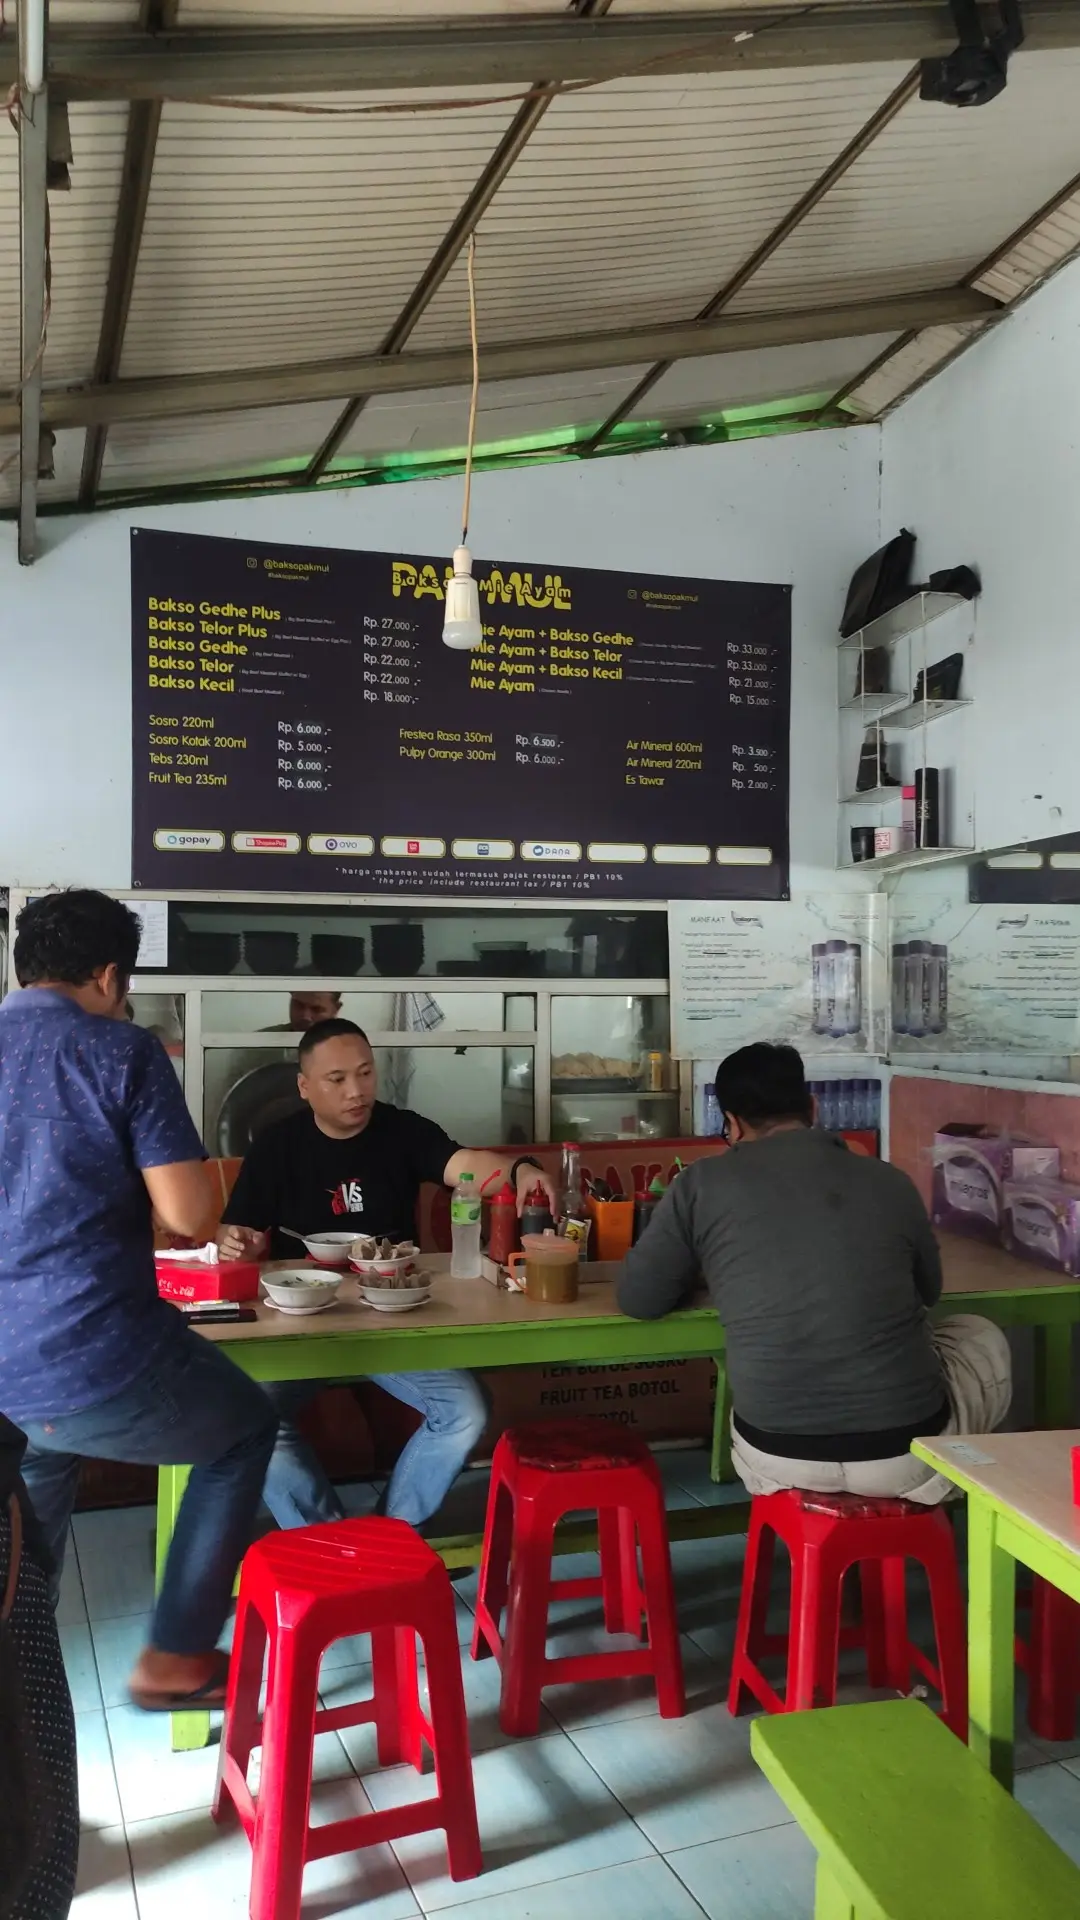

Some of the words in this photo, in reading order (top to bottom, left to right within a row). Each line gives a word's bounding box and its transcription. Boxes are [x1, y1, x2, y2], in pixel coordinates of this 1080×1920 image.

[263, 559, 329, 573] @baksopakmul
[521, 583, 571, 598] Ayam
[148, 597, 195, 614] Bakso
[199, 602, 248, 618] Gedhe
[252, 605, 281, 621] Plus
[148, 617, 195, 633] Bakso
[199, 620, 234, 636] Telor
[238, 623, 268, 638] Plus
[363, 616, 379, 629] Rp.
[363, 634, 379, 647] Rp.
[498, 624, 535, 641] Ayam
[538, 629, 546, 638] +
[550, 628, 589, 643] Bakso
[592, 631, 634, 646] Gedhe
[148, 636, 195, 652] Bakso
[199, 640, 248, 655] Gedhe
[498, 643, 535, 658] Ayam
[538, 647, 546, 655] +
[550, 646, 589, 660] Bakso
[592, 649, 622, 662] Telor
[148, 655, 195, 671] Bakso
[199, 658, 234, 673] Telor
[363, 652, 379, 666] Rp.
[471, 659, 495, 672] Mie
[498, 661, 535, 676] Ayam
[538, 665, 546, 673] +
[550, 664, 589, 678] Bakso
[592, 667, 623, 680] Kecil
[148, 674, 195, 690] Bakso
[200, 677, 234, 692] Kecil
[363, 671, 379, 684] Rp.
[471, 677, 495, 690] Mie
[498, 679, 535, 694] Ayam
[363, 689, 379, 703] Rp.
[149, 714, 179, 727] Sosro
[182, 716, 214, 728] 220ml
[278, 721, 294, 735] Rp.
[149, 733, 179, 745] Sosro
[181, 735, 211, 747] Kotak
[214, 736, 247, 749] 200ml
[399, 728, 434, 741] Frestea
[436, 730, 461, 742] Rasa
[463, 731, 493, 743] 350ml
[515, 734, 531, 747] Rp.
[278, 739, 294, 753] Rp.
[626, 740, 639, 750] Air
[640, 740, 673, 752] Mineral
[675, 742, 703, 753] 600ml
[149, 752, 173, 765] Tebs
[176, 754, 209, 766] 230ml
[399, 746, 426, 760] Pulpy
[427, 748, 463, 762] Orange
[466, 749, 496, 761] 300ml
[515, 751, 531, 764] Rp.
[278, 758, 294, 772] Rp.
[626, 757, 639, 767] Air
[640, 758, 673, 769] Mineral
[675, 759, 702, 770] 220ml
[149, 772, 171, 784] Fruit
[174, 772, 192, 784] Tea
[195, 774, 227, 786] 235ml
[278, 776, 294, 790] Rp.
[625, 774, 636, 785] Es
[638, 775, 665, 786] Tawar
[178, 836, 211, 845] gopay
[399, 878, 424, 886] price
[430, 878, 465, 886] include
[470, 879, 520, 887] restaurant
[341, 1182, 363, 1212] VS
[540, 1388, 587, 1405] FRUIT
[593, 1384, 623, 1400] TEA
[628, 1379, 680, 1398] BOTOL
